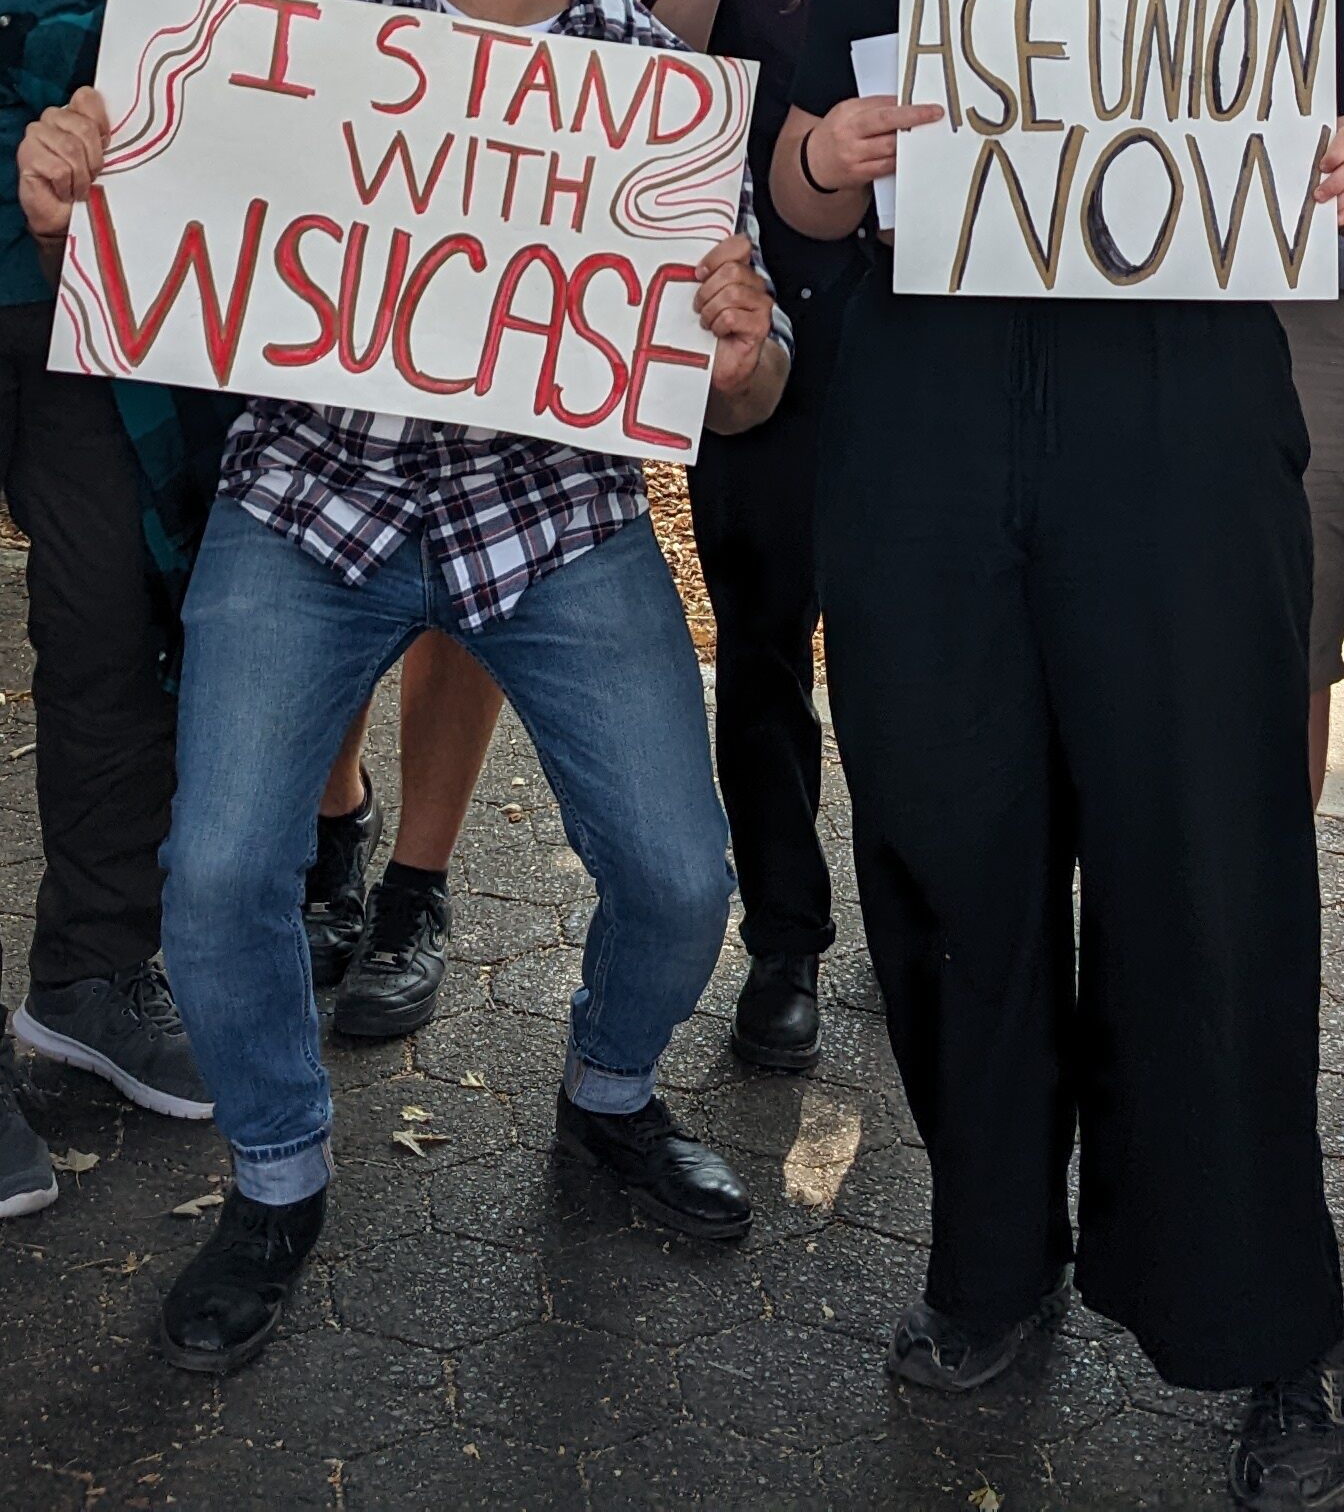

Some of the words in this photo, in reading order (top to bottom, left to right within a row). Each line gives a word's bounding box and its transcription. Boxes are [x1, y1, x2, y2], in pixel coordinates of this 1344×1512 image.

[370, 14, 714, 150] STAND
[342, 120, 595, 233] WITH
[948, 124, 1331, 292] NOW
[88, 184, 710, 450] WSUCASE
